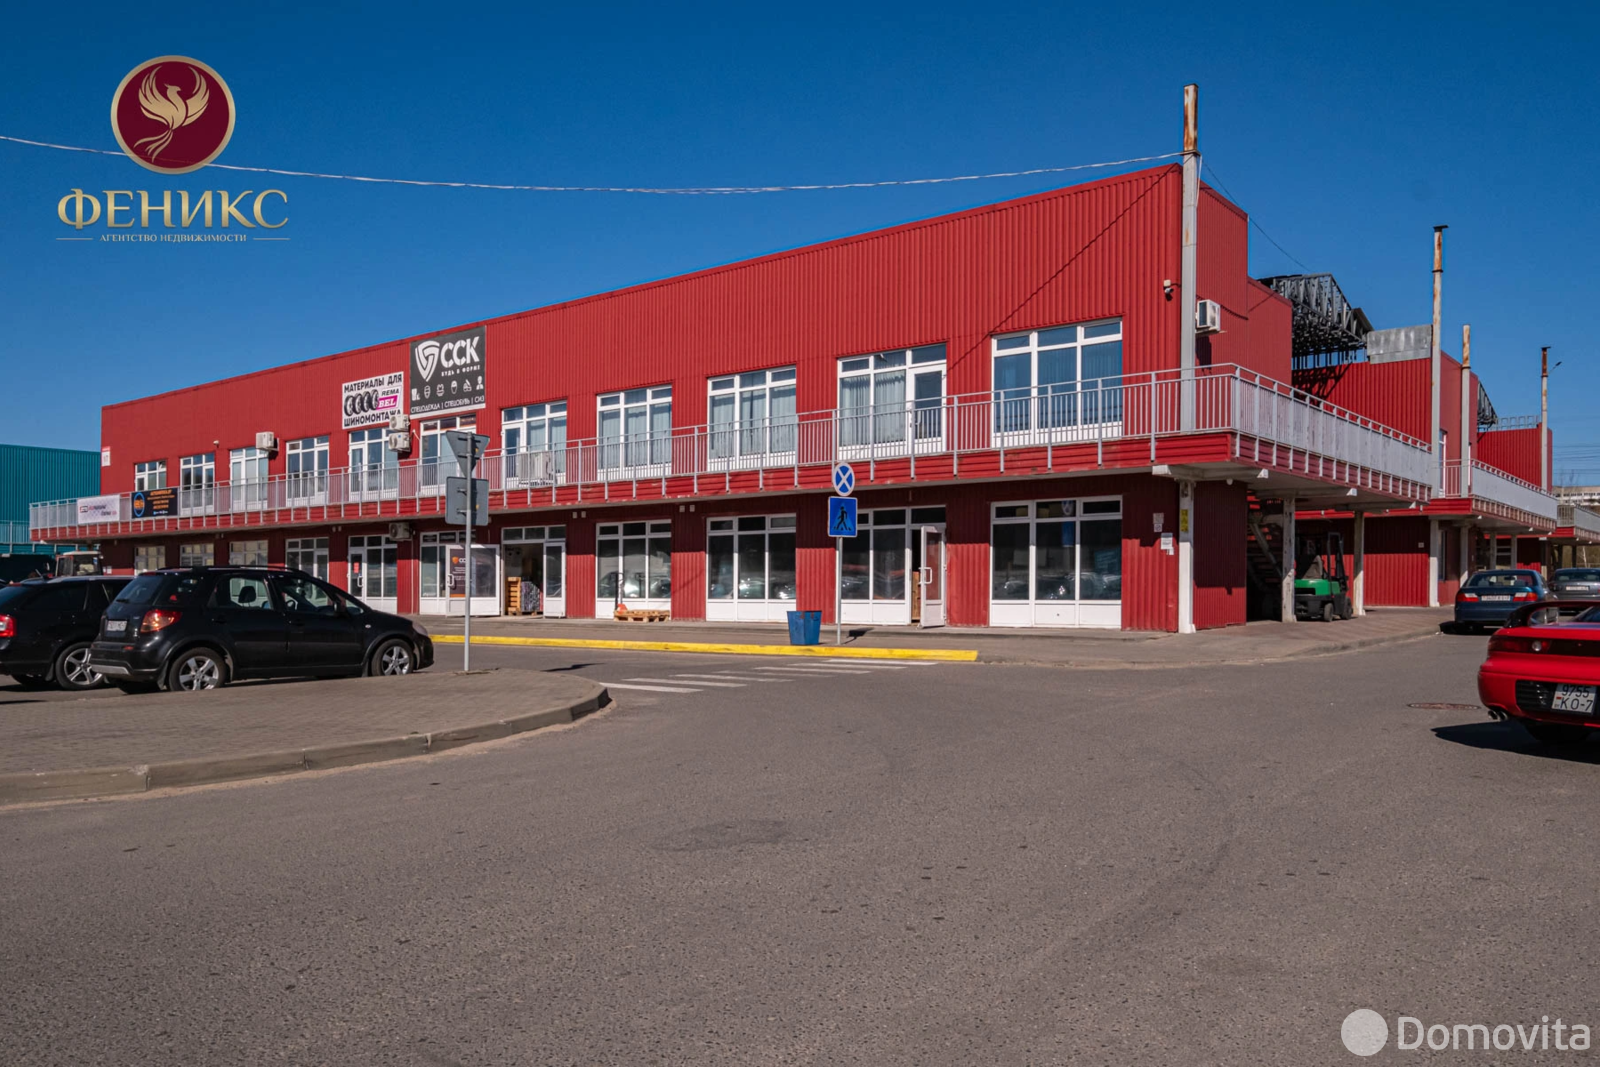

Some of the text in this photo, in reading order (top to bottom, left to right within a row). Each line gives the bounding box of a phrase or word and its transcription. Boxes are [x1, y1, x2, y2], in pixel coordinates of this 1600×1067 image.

[440, 336, 480, 369] ССК
[344, 373, 402, 393] МАТЕРИАЛЫ ДЛЯ
[381, 388, 400, 396] REMA
[379, 399, 396, 408] BEL
[410, 402, 441, 414] СПЕЦОДЕЖДА
[444, 397, 471, 408] СПЕЦОБУВЬ
[1561, 685, 1590, 698] 9755
[1560, 697, 1594, 711] KO-7
